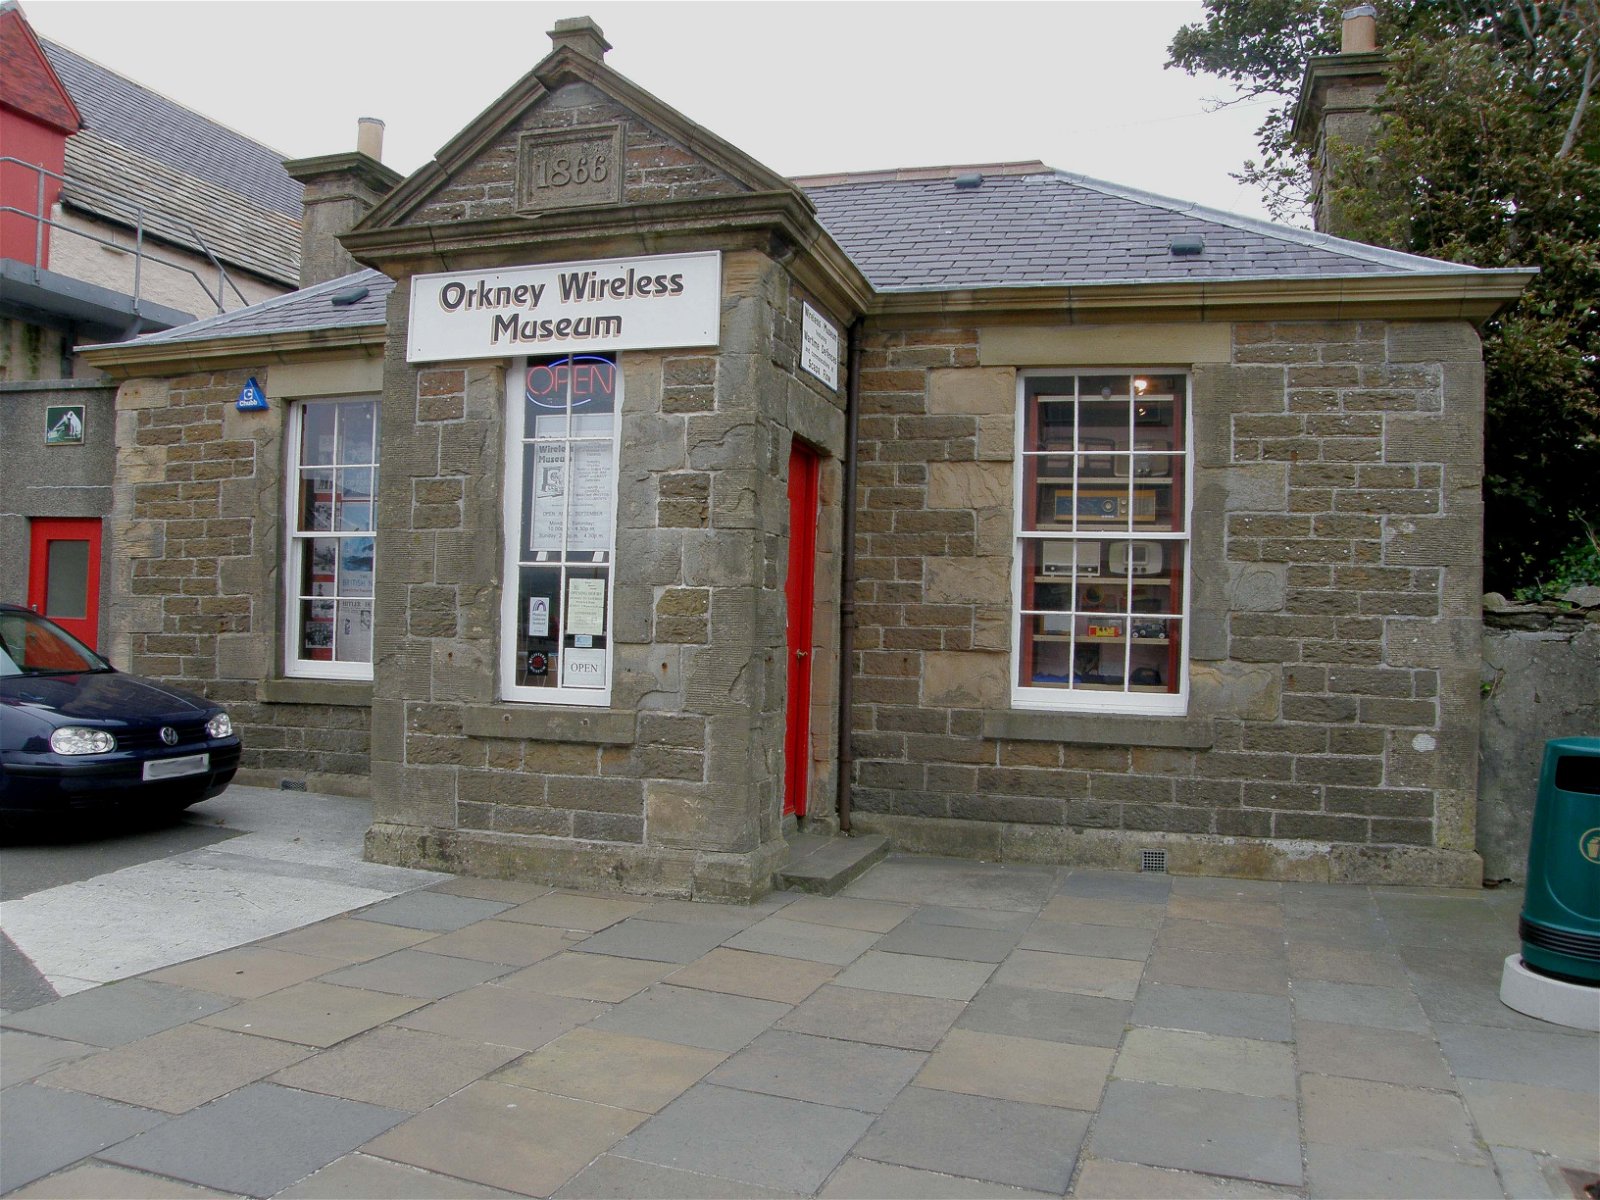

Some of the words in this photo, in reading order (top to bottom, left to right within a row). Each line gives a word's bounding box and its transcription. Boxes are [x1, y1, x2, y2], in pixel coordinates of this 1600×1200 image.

[537, 155, 607, 189] 1866
[439, 280, 546, 313] Orkney
[558, 268, 684, 304] Wireless
[491, 313, 623, 345] Museum
[527, 364, 613, 395] OPEN
[240, 399, 258, 407] Chubb
[538, 444, 575, 454] Wireles
[570, 663, 598, 673] OPEN
